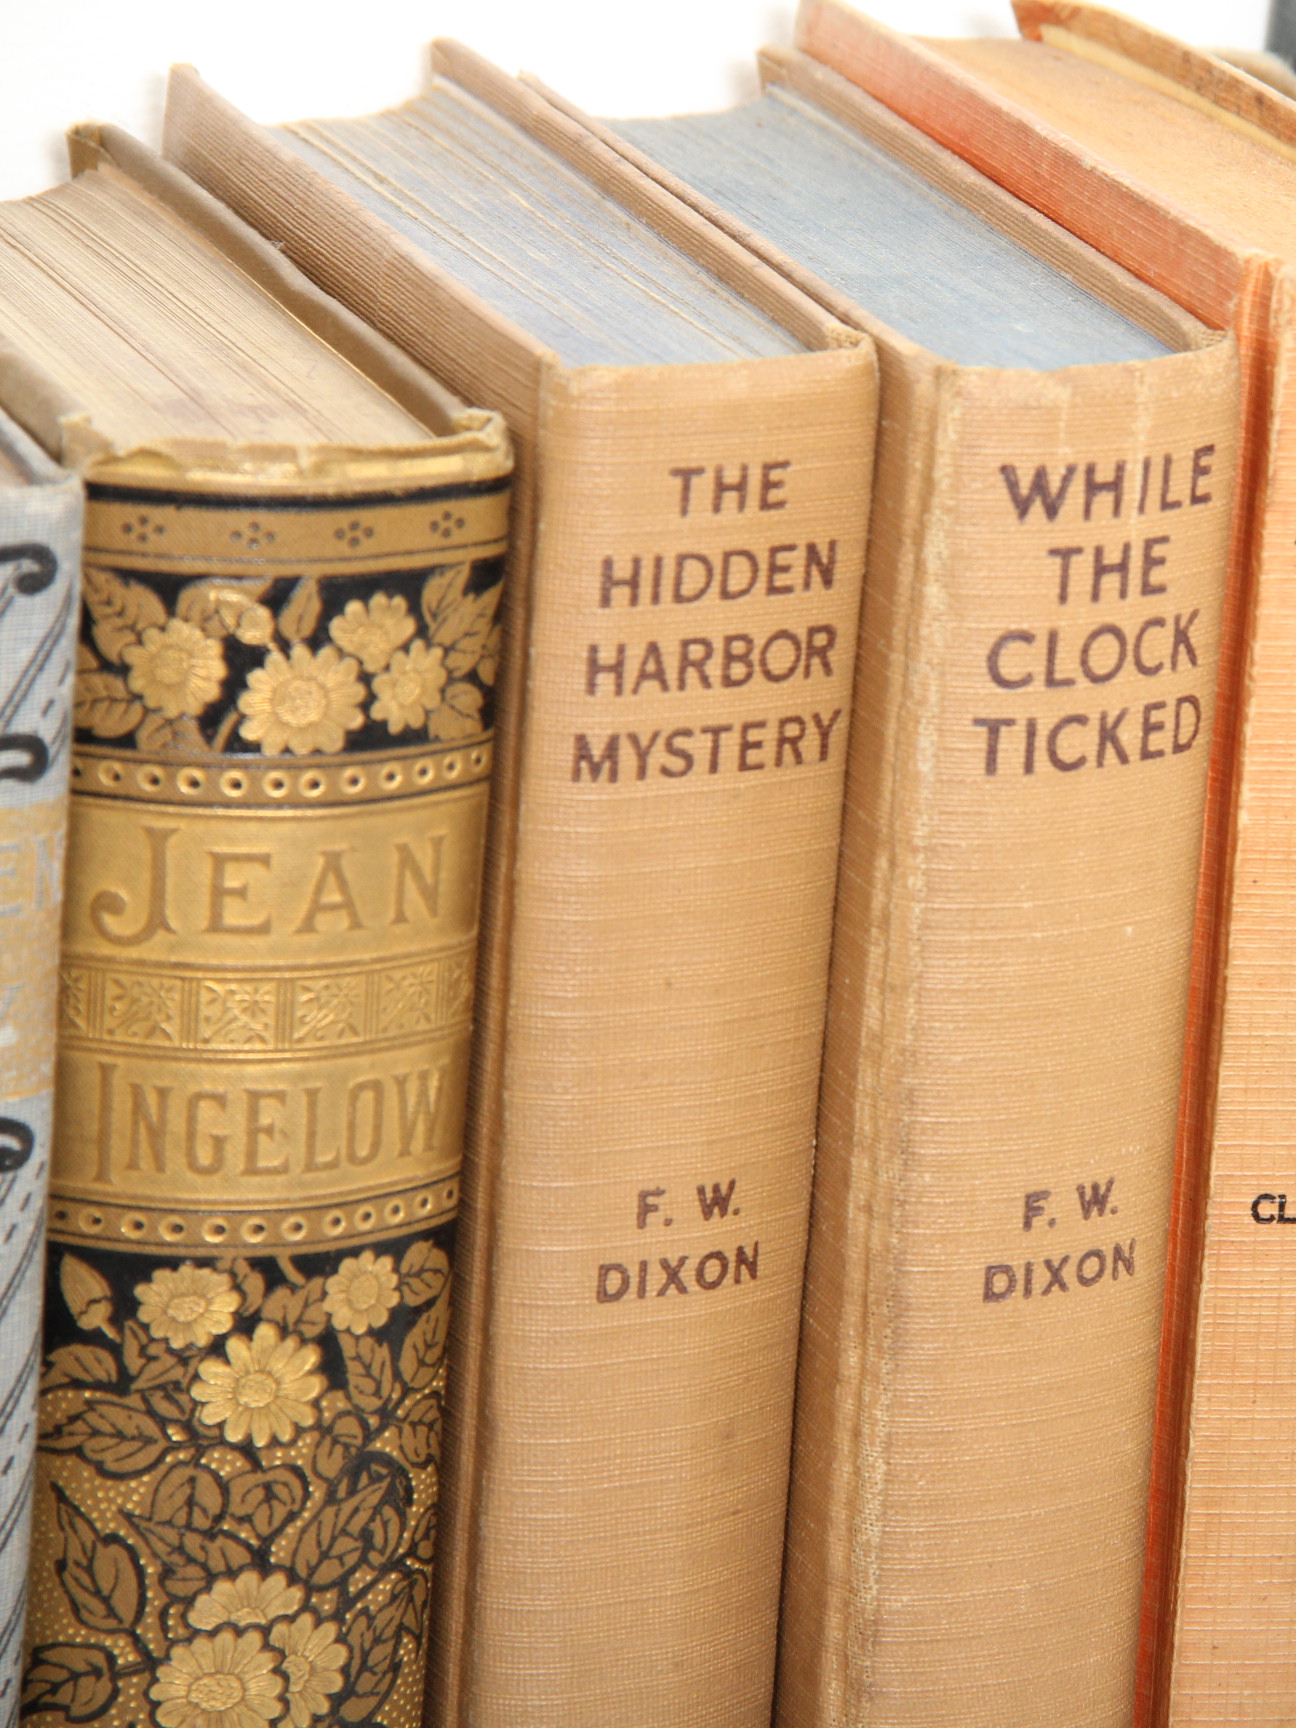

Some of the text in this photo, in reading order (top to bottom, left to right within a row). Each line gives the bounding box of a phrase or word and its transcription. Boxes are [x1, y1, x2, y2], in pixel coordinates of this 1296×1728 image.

[670, 460, 791, 517] THE
[999, 444, 1215, 523] WHILE
[599, 539, 838, 609] HIDDEN
[1048, 536, 1170, 605] THE
[585, 624, 837, 696] HARBOR
[986, 608, 1200, 690] CLOCK
[570, 709, 842, 784] MYSTERY
[972, 694, 1201, 776] TICKED
[90, 825, 446, 944] JEAN
[94, 1061, 448, 1184] INGELOW
[637, 1178, 741, 1229] F. W.
[1022, 1178, 1119, 1232] F. W.
[595, 1241, 760, 1303] DIXON
[982, 1239, 1137, 1304] DIXON
